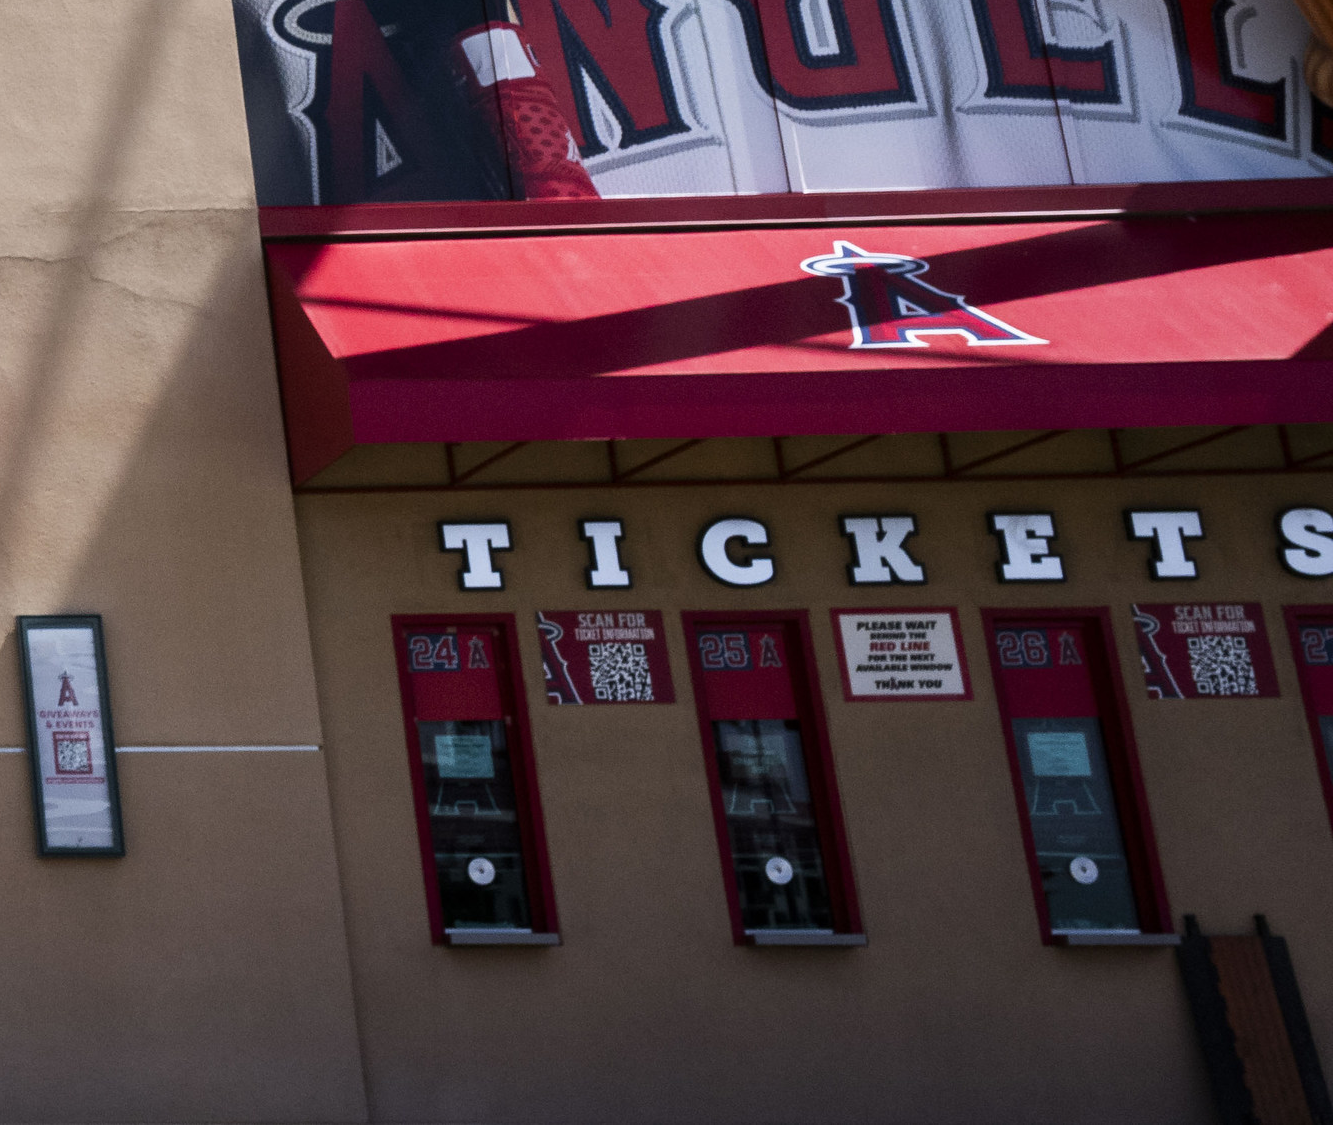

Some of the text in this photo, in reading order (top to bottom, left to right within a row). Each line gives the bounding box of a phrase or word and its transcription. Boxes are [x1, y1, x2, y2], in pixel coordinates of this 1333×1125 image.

[800, 239, 1049, 350] A
[1174, 605, 1246, 620] SCAN FOR
[577, 613, 646, 627] SCAN FOR
[857, 621, 937, 631] PLEASE WAIT
[575, 627, 601, 641] TICKET
[909, 632, 926, 640] THE
[410, 635, 458, 669] 24
[700, 633, 749, 669] 25
[870, 641, 930, 652] RED LINE
[996, 630, 1047, 667] 26
[868, 653, 935, 662] FOR THE NEXT
[856, 663, 953, 672] AVAILABLE WINDOW
[875, 678, 943, 691] THANK YOU
[39, 709, 100, 720] GIVEAWAYS
[55, 720, 96, 729] EVENTS
